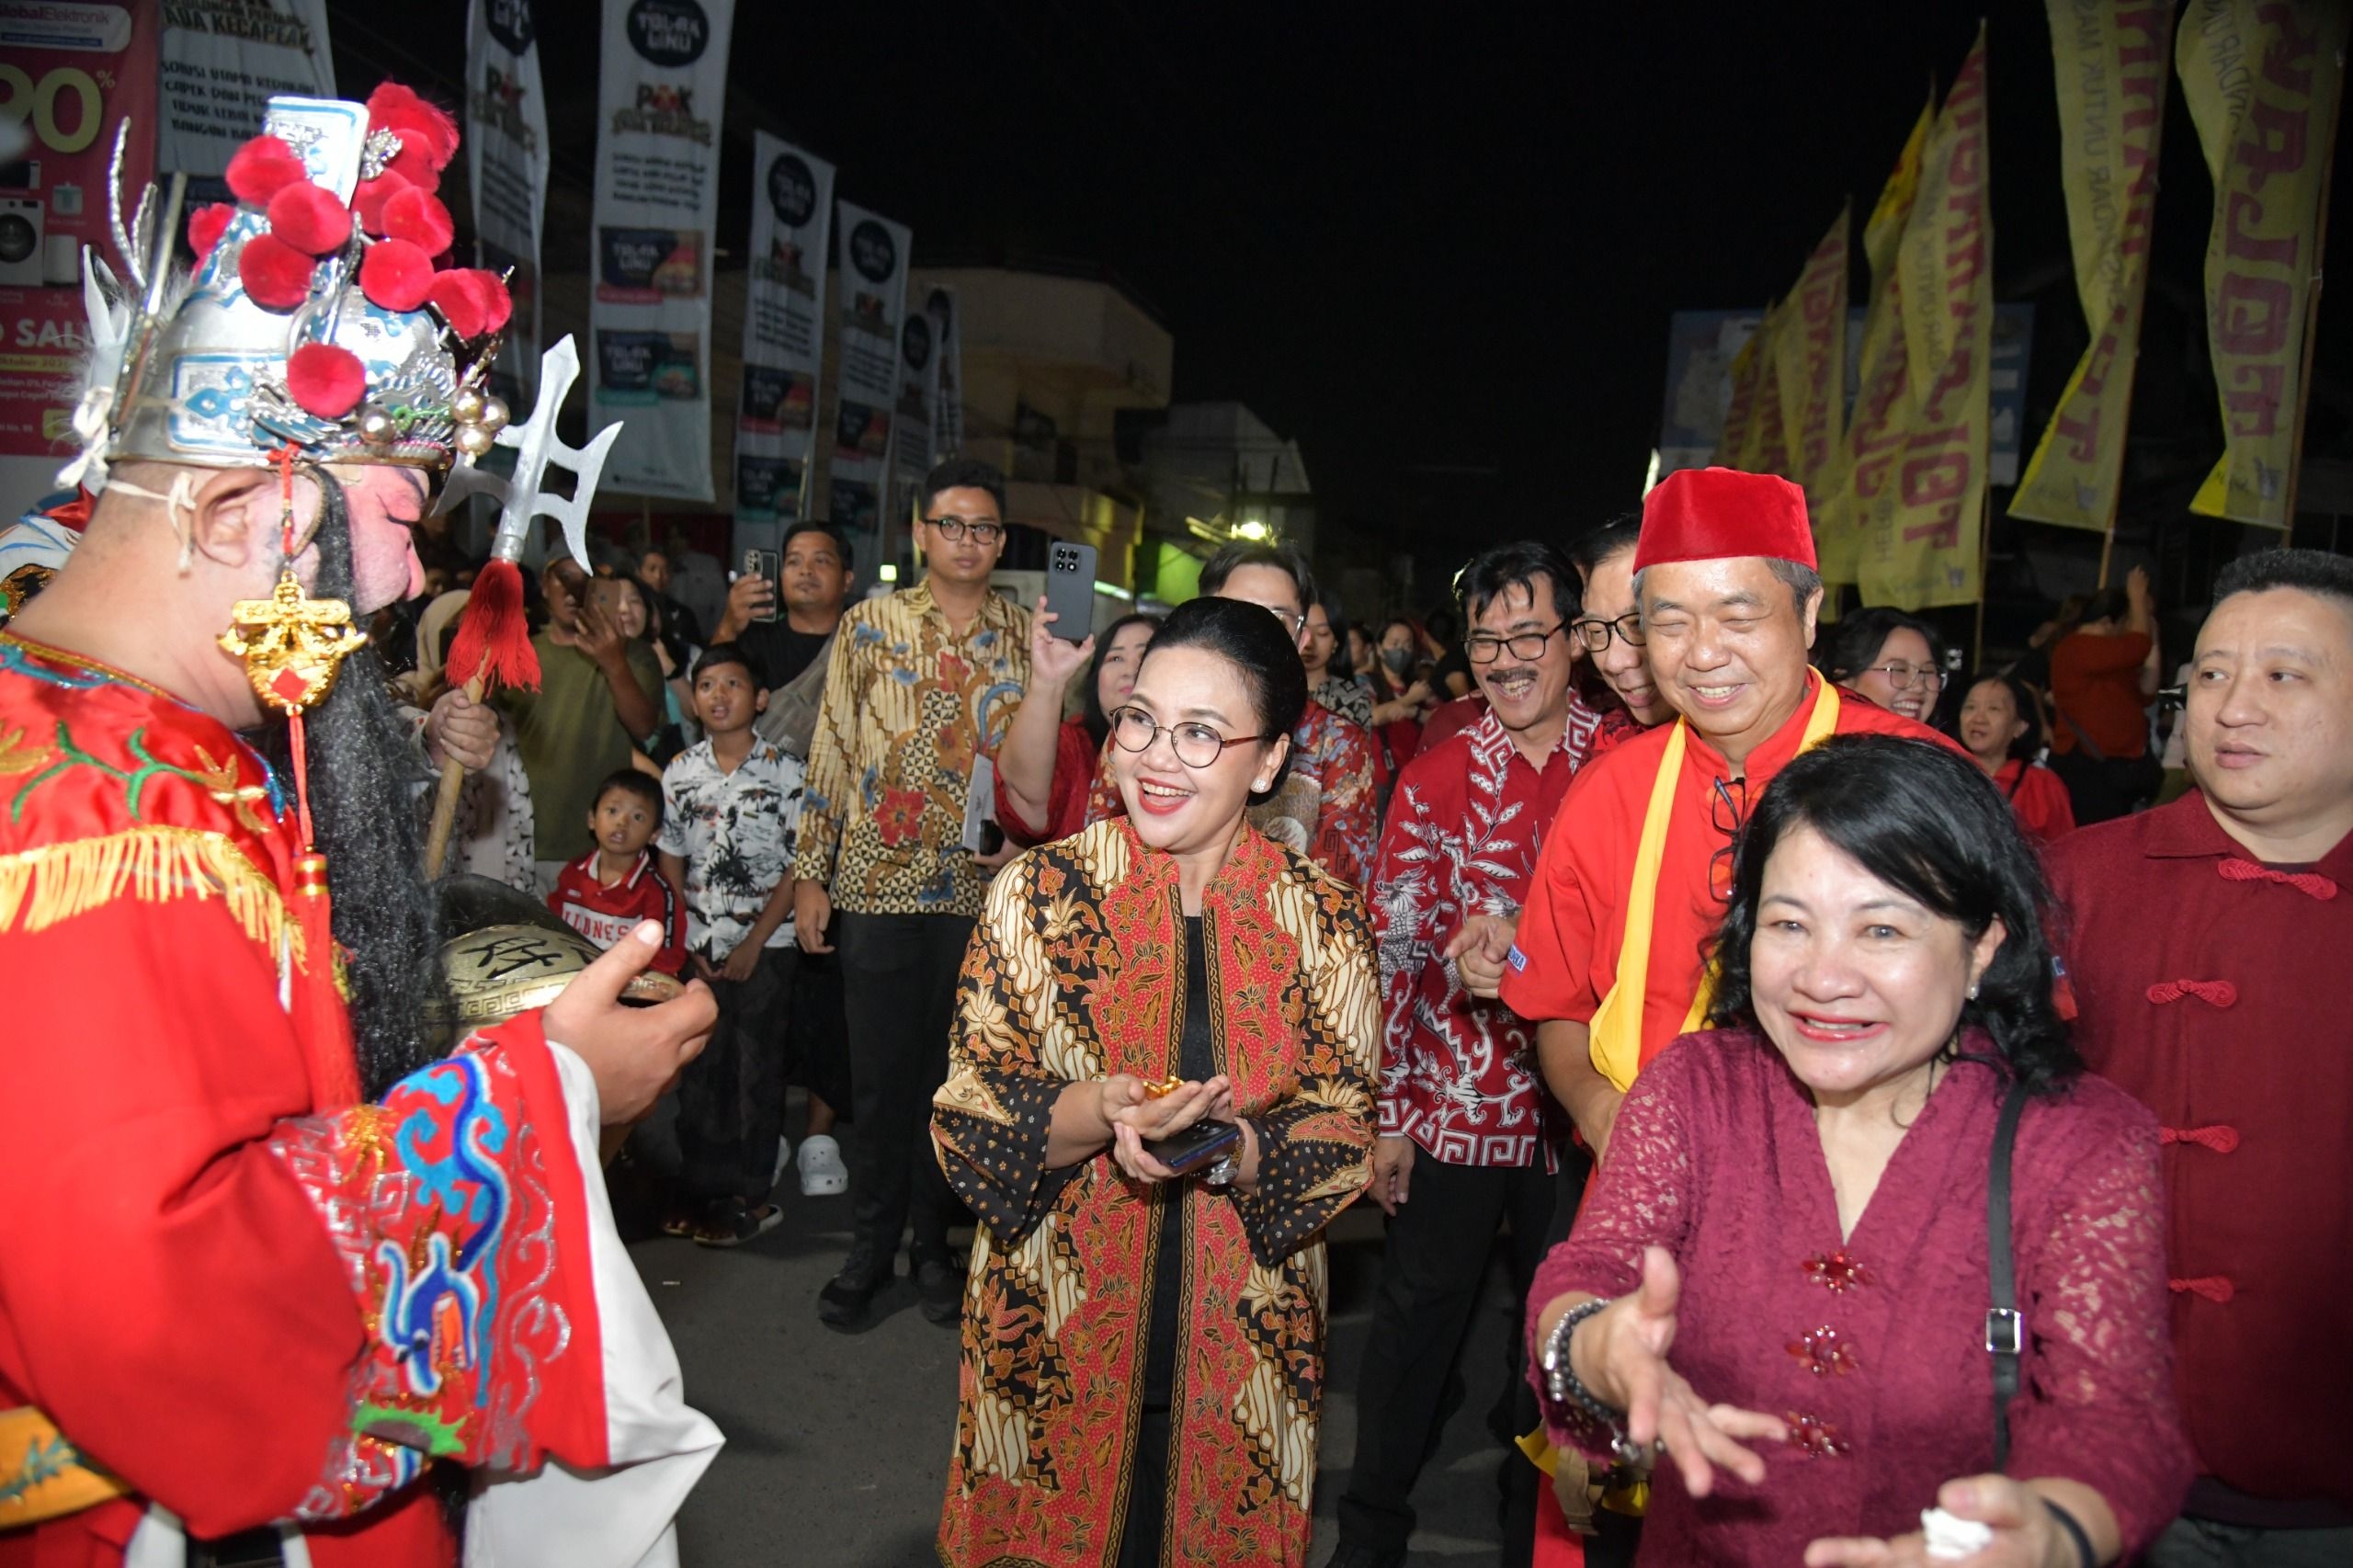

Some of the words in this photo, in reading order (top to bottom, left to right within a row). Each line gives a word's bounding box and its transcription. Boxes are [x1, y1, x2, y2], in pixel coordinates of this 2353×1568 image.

[165, 6, 209, 34] ADA
[160, 61, 206, 79] SOLUSI
[165, 81, 207, 97] CAPEK
[210, 86, 240, 103] DAN
[15, 317, 96, 349] SAL
